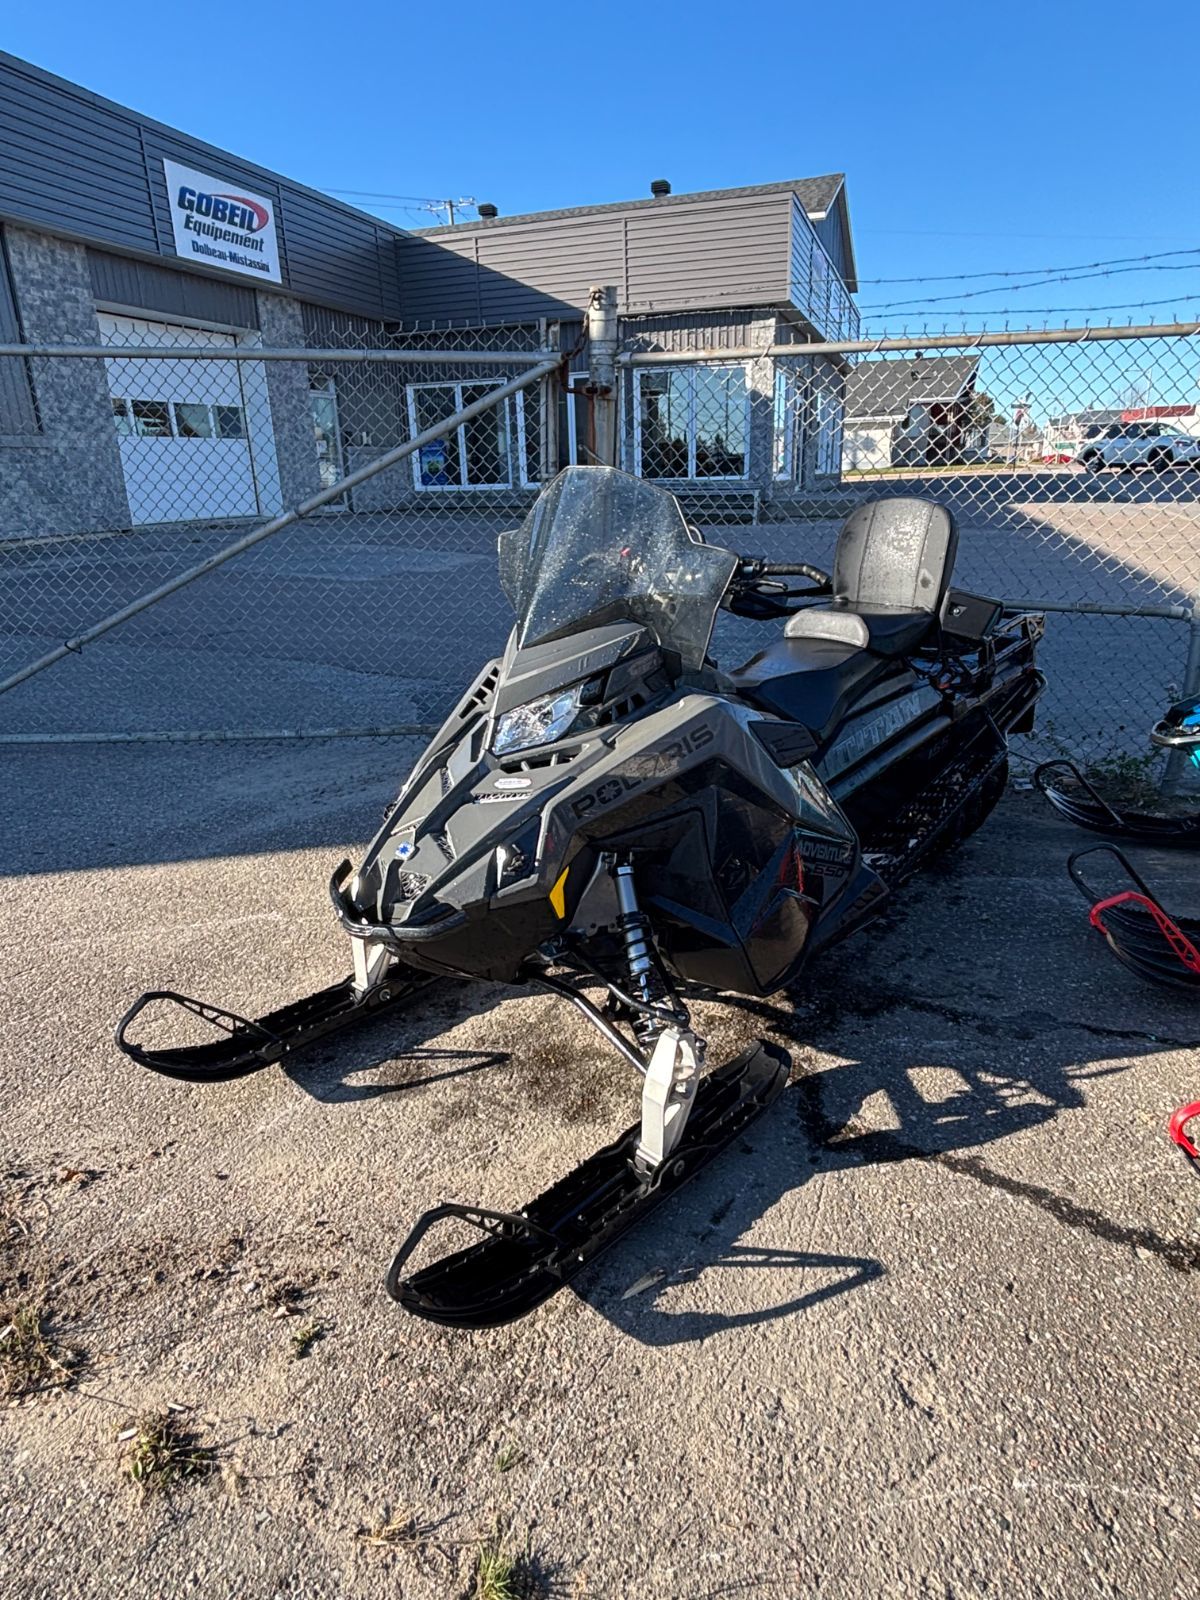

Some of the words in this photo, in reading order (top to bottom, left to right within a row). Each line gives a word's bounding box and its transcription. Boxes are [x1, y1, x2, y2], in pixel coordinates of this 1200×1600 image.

[177, 186, 257, 233] GOBEIL
[191, 240, 270, 272] Dolbeau-Mistassini
[832, 692, 922, 765] TITAN
[571, 723, 714, 820] POLARIS
